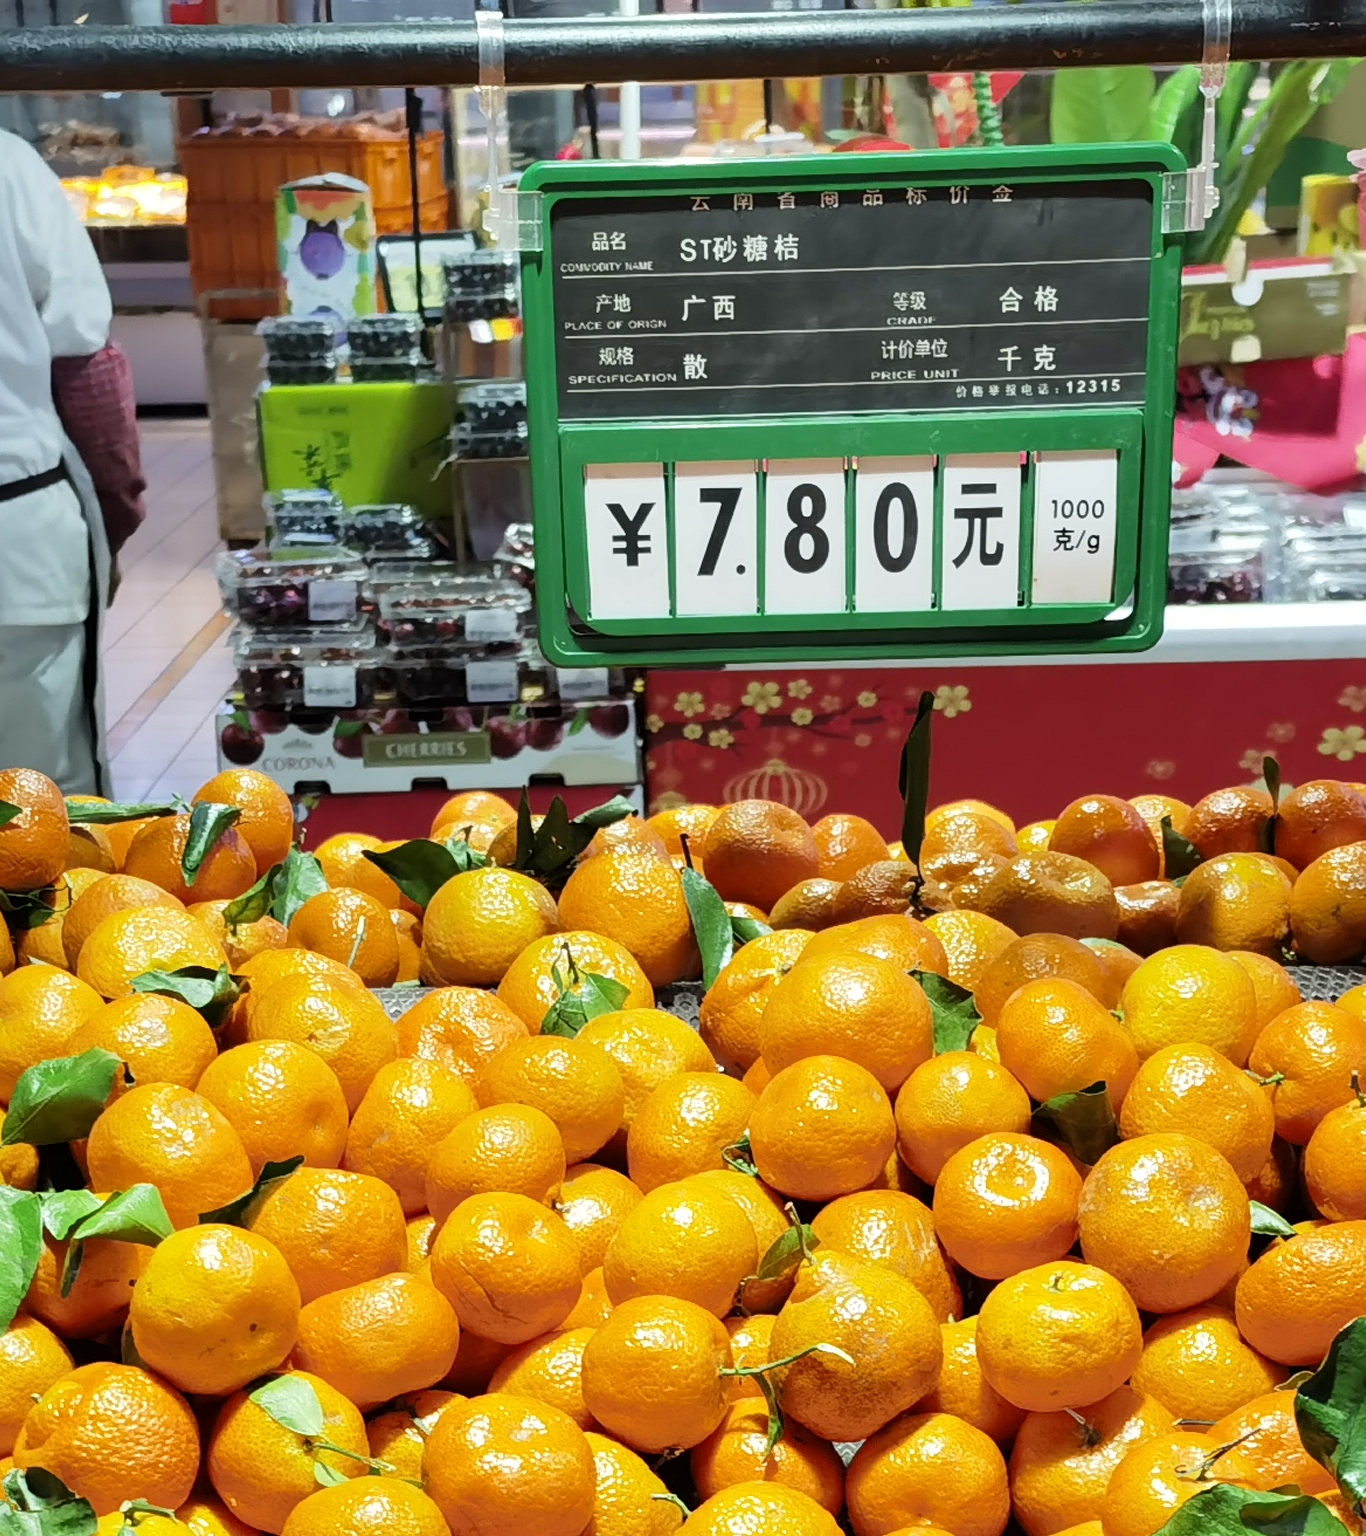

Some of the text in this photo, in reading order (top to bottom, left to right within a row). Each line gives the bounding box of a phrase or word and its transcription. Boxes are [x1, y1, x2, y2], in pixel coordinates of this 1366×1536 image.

[591, 231, 627, 252] 品名
[680, 234, 800, 263] ST砂糖桔
[560, 261, 654, 273] COMMODITY NAME
[595, 293, 632, 314] 产地
[681, 294, 736, 322] 广西
[893, 290, 927, 311] 等级
[998, 285, 1059, 313] 合格
[564, 320, 603, 332] PLACE
[606, 320, 624, 331] OF
[598, 346, 634, 366] 规格
[881, 338, 949, 360] 计价单位
[997, 344, 1057, 372] 千克
[682, 353, 708, 380] 散
[871, 368, 960, 381] PRICE UNIT
[568, 372, 677, 384] SPECIFICATION
[1050, 499, 1106, 520] 1000
[1052, 528, 1101, 554] 克/g
[385, 741, 468, 759] CHERRIES
[261, 756, 336, 773] CORONA
